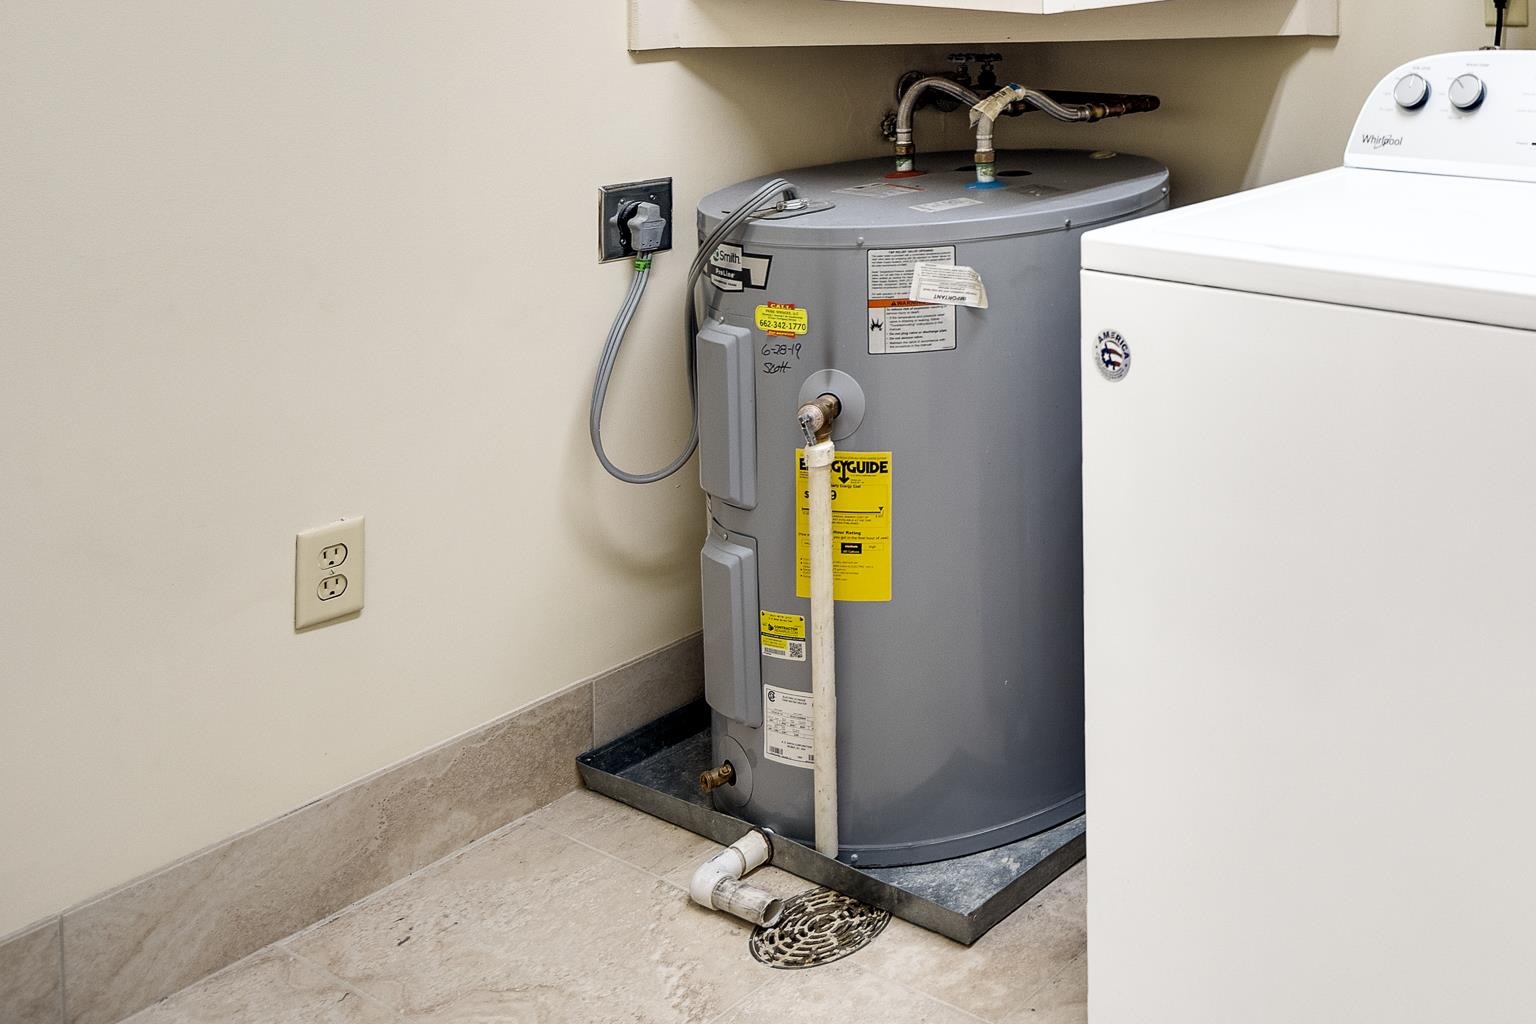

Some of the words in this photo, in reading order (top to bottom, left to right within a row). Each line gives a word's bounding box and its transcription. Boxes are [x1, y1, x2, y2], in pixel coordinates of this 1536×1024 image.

[1361, 134, 1403, 149] Whirlpool
[759, 319, 807, 331] 662-342-1770
[1098, 331, 1130, 360] AMERICA
[800, 458, 888, 475] EGYGUIDE
